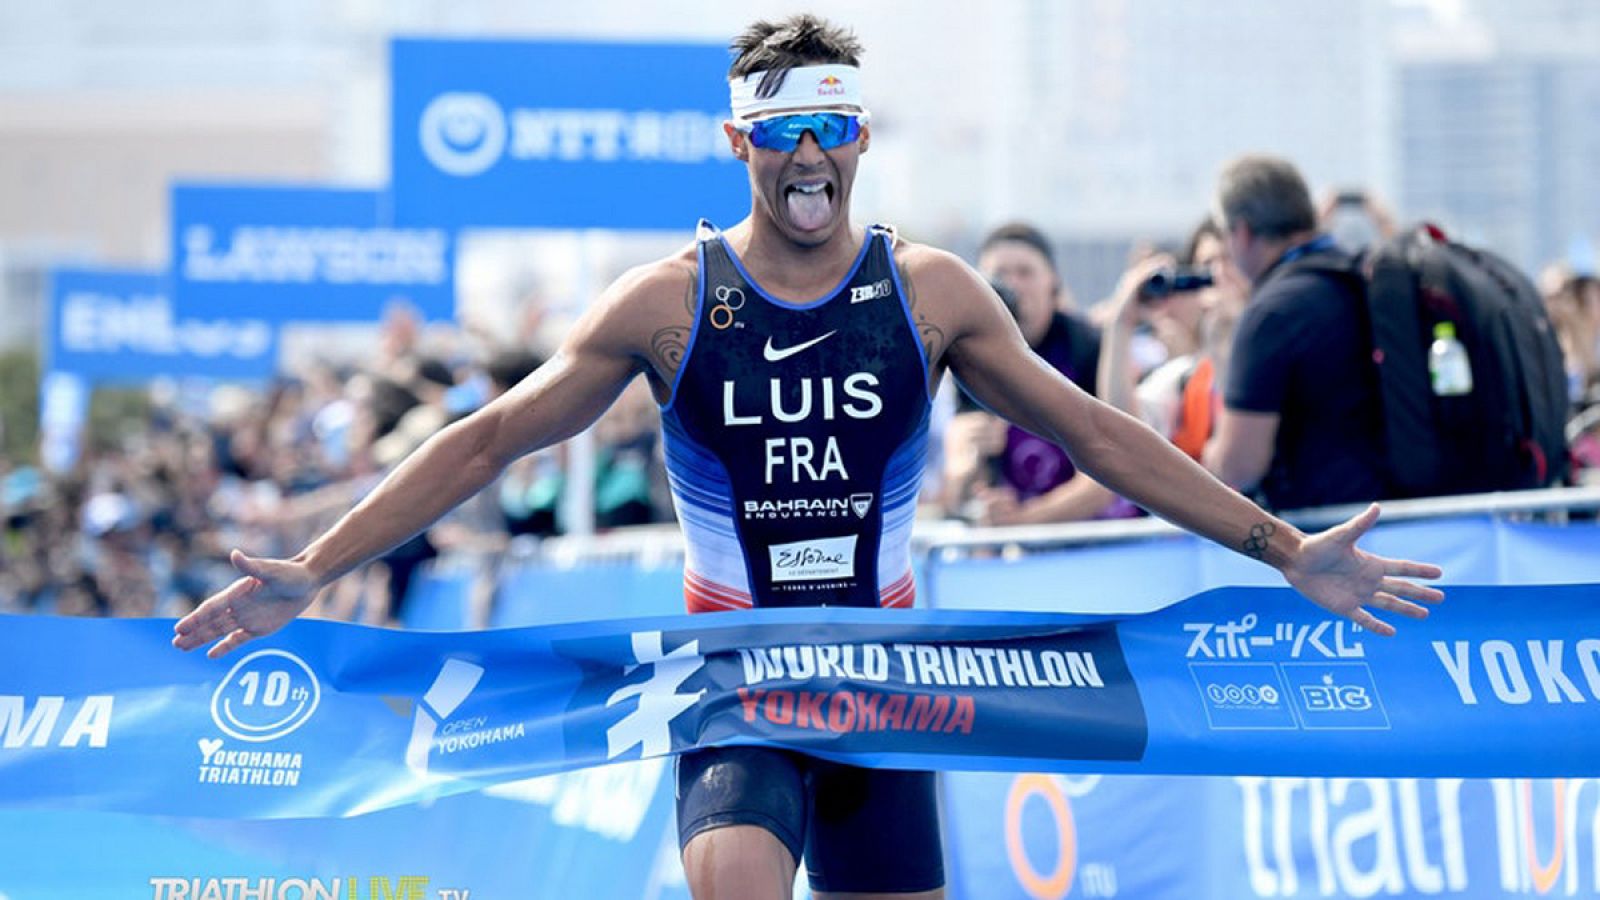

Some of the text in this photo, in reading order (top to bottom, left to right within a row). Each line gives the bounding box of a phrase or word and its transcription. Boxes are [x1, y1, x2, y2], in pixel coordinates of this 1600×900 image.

[723, 372, 883, 426] LUIS
[765, 435, 849, 484] FRA
[744, 498, 848, 512] BAHRAIN
[744, 510, 848, 520] ENDURANCE
[1183, 613, 1366, 658] スポーツくじ
[740, 643, 1104, 688] WORLD TRIATHLON
[737, 688, 976, 735] YOKOHAMA
[1300, 684, 1372, 710] BIG
[437, 722, 525, 755] YOKOHAMA
[442, 716, 488, 736] OPEN
[197, 738, 302, 769] YOKOHAMA
[198, 766, 300, 786] TRIATHLON
